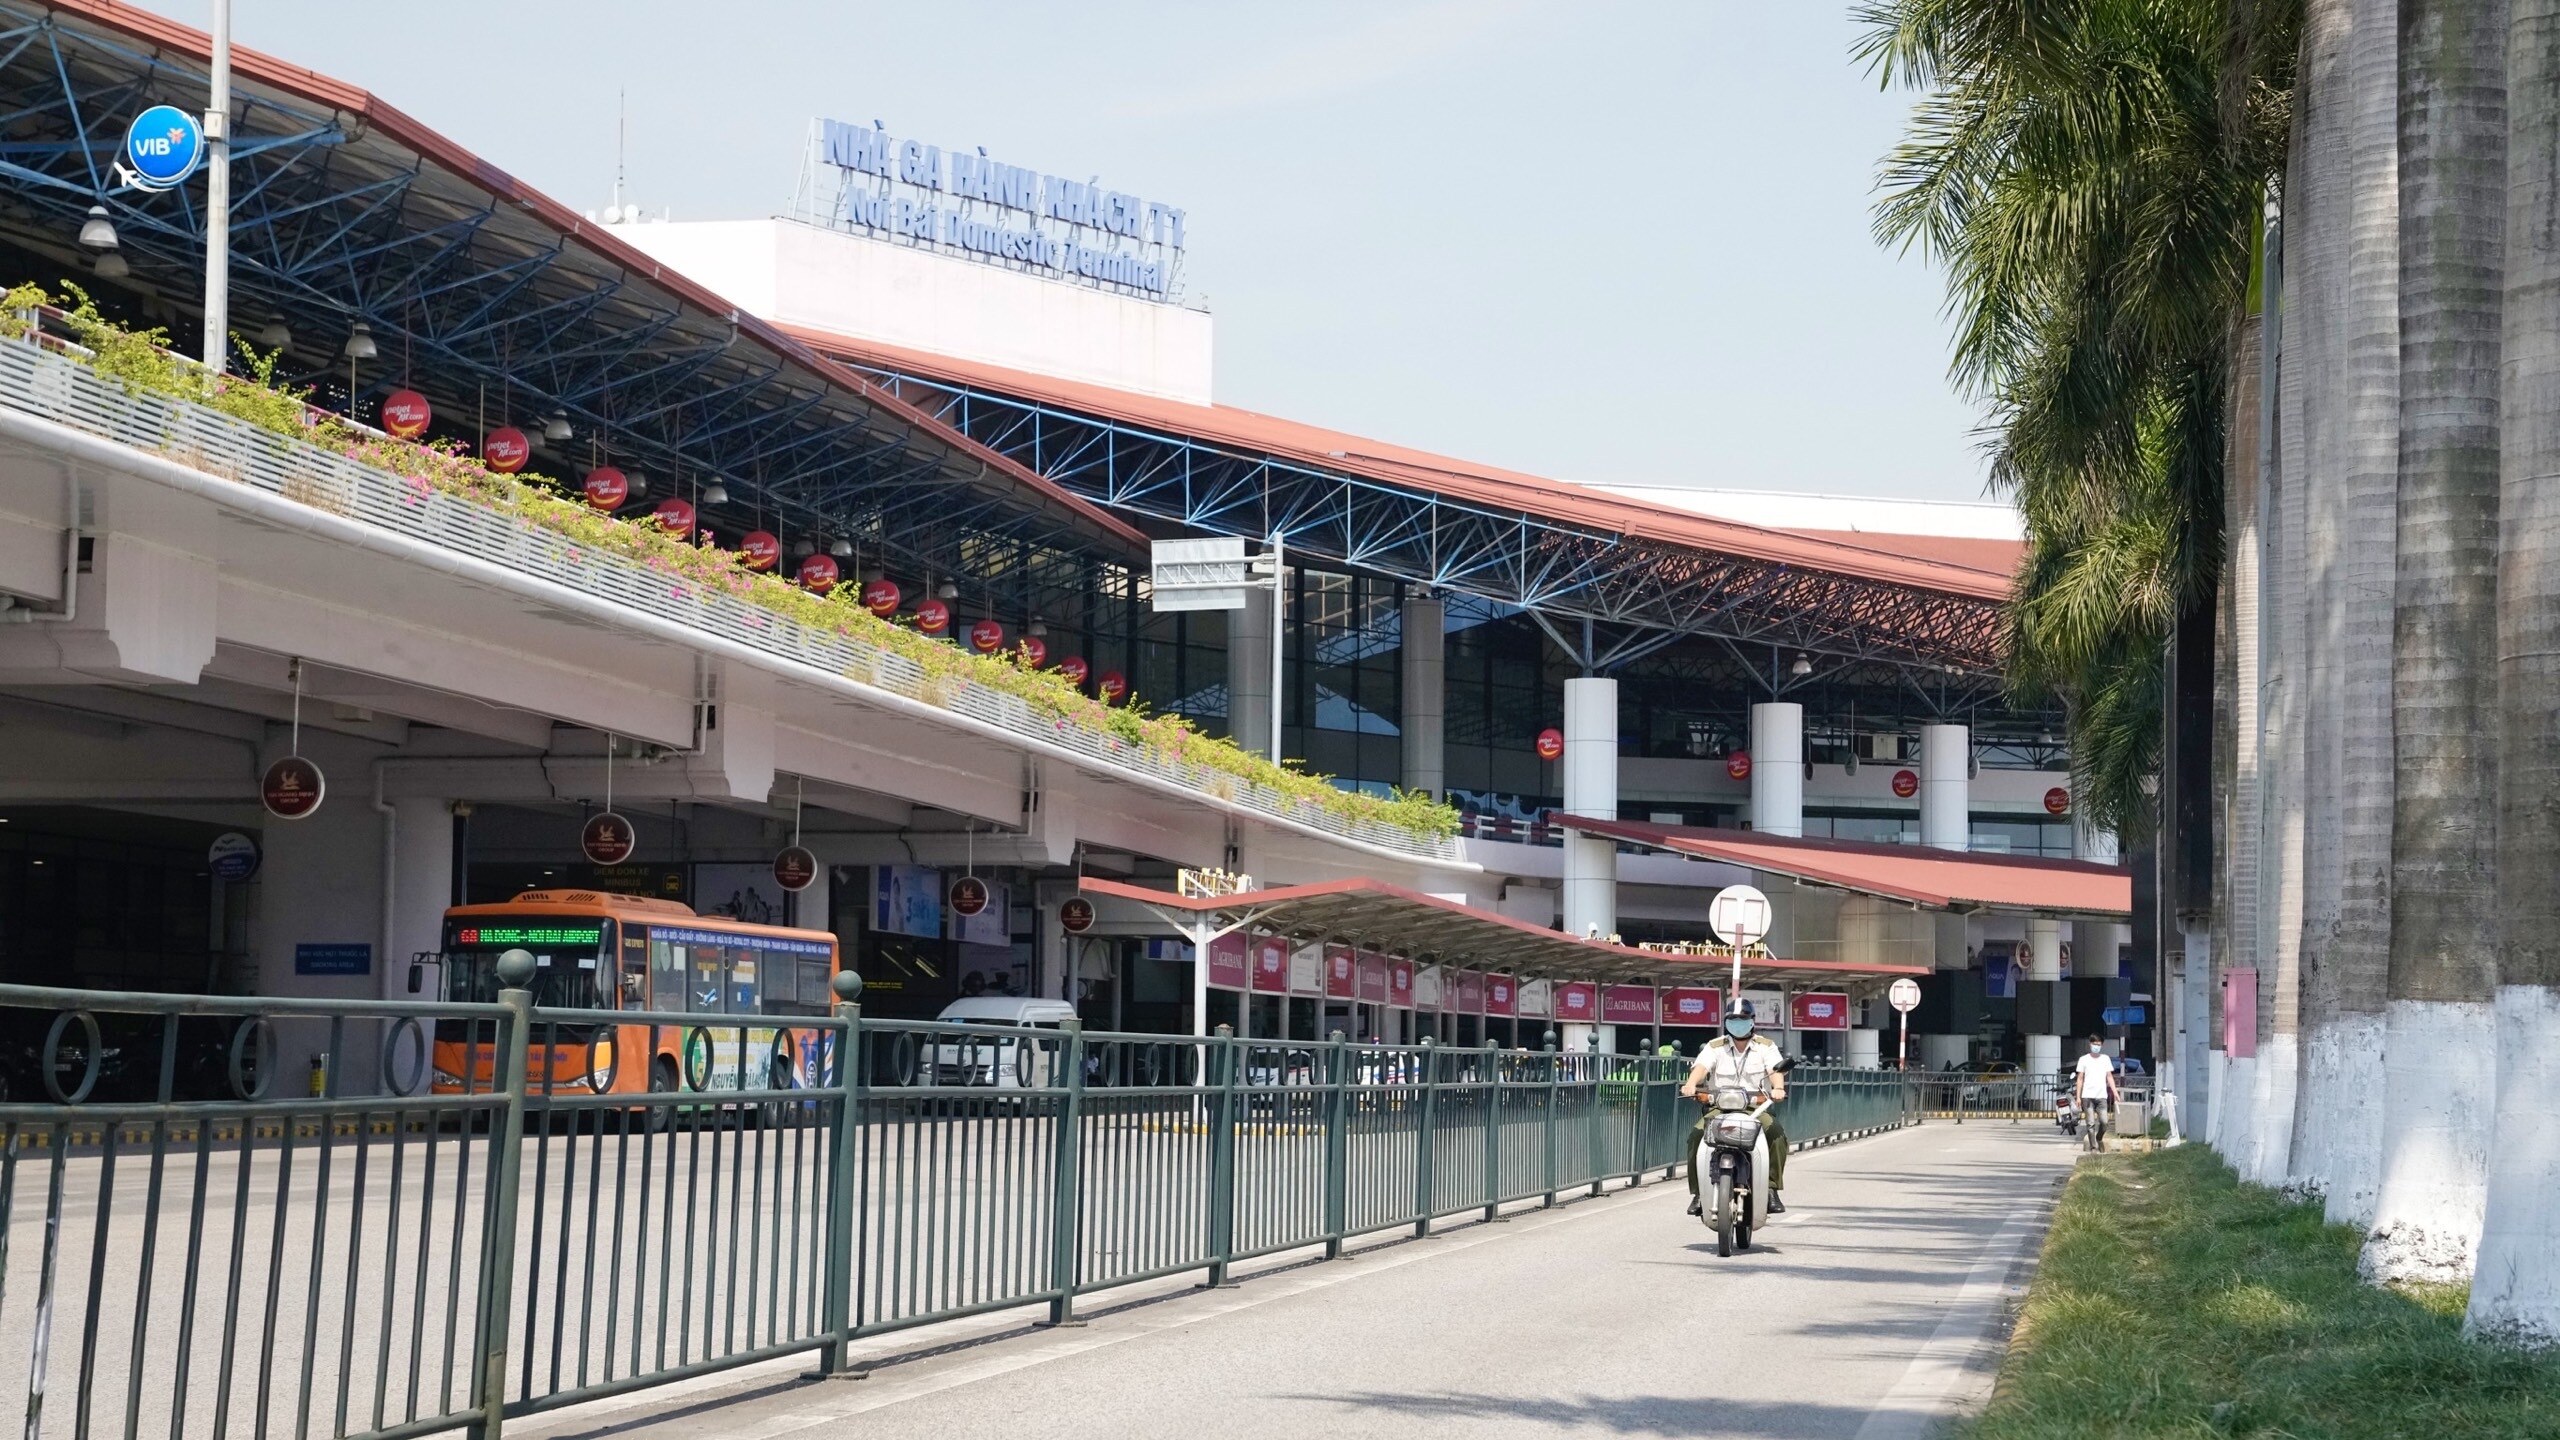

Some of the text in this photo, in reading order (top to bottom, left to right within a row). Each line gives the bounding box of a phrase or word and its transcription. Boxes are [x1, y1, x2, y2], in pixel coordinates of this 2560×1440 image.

[135, 138, 171, 157] VIB
[822, 118, 1184, 250] NHÀ GA HÀNH KHÁCH T1
[944, 209, 1060, 269] Domestic
[1064, 237, 1165, 294] Terminal
[604, 878, 641, 887] MINIBUS
[1613, 1000, 1651, 1012] AGRIBANK
